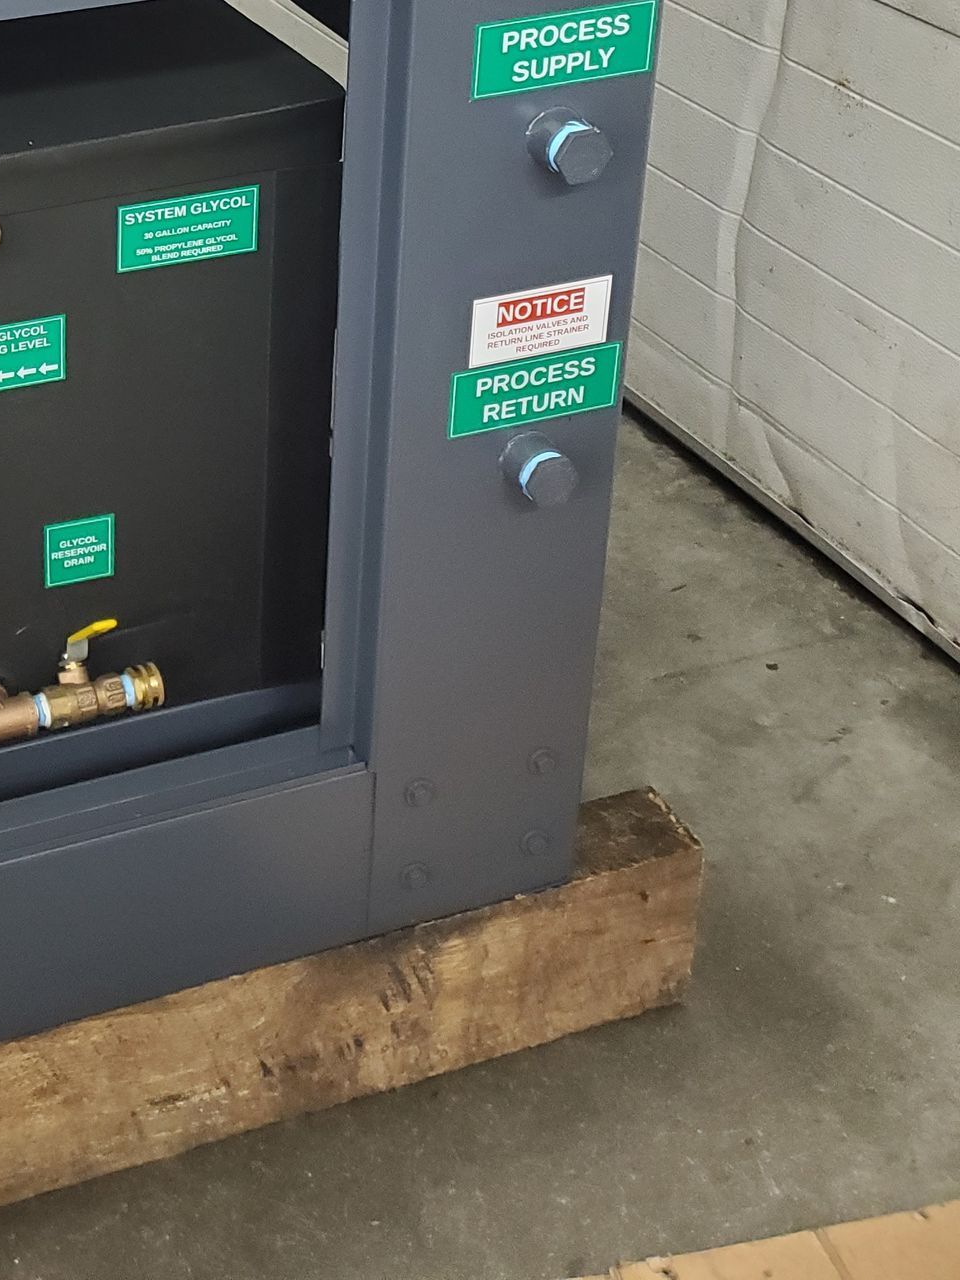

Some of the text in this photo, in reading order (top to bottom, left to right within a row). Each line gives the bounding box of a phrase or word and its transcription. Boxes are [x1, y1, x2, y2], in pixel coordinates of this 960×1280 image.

[502, 14, 631, 53] PROCESS
[512, 47, 615, 82] SUPPLY
[125, 196, 251, 225] SYSTEM GLYCOL
[155, 227, 189, 238] GALLON
[191, 220, 232, 232] CAPACITY
[151, 245, 223, 261] BLEND REQUIRED
[154, 239, 204, 253] PROPYLENE
[205, 234, 238, 245] GLYCOL
[498, 291, 585, 323] NOTICE
[487, 324, 589, 349] RETURN LINE STRAINER
[488, 315, 588, 339] ISOLATION VALVES AND
[11, 337, 51, 352] LEVEL
[516, 339, 560, 353] REQUIRED
[476, 357, 596, 397] PROCESS
[483, 386, 585, 423] RETURN
[51, 544, 106, 560] RESERVOIR
[59, 536, 98, 548] GLYCOL
[64, 556, 94, 567] DRAIN
